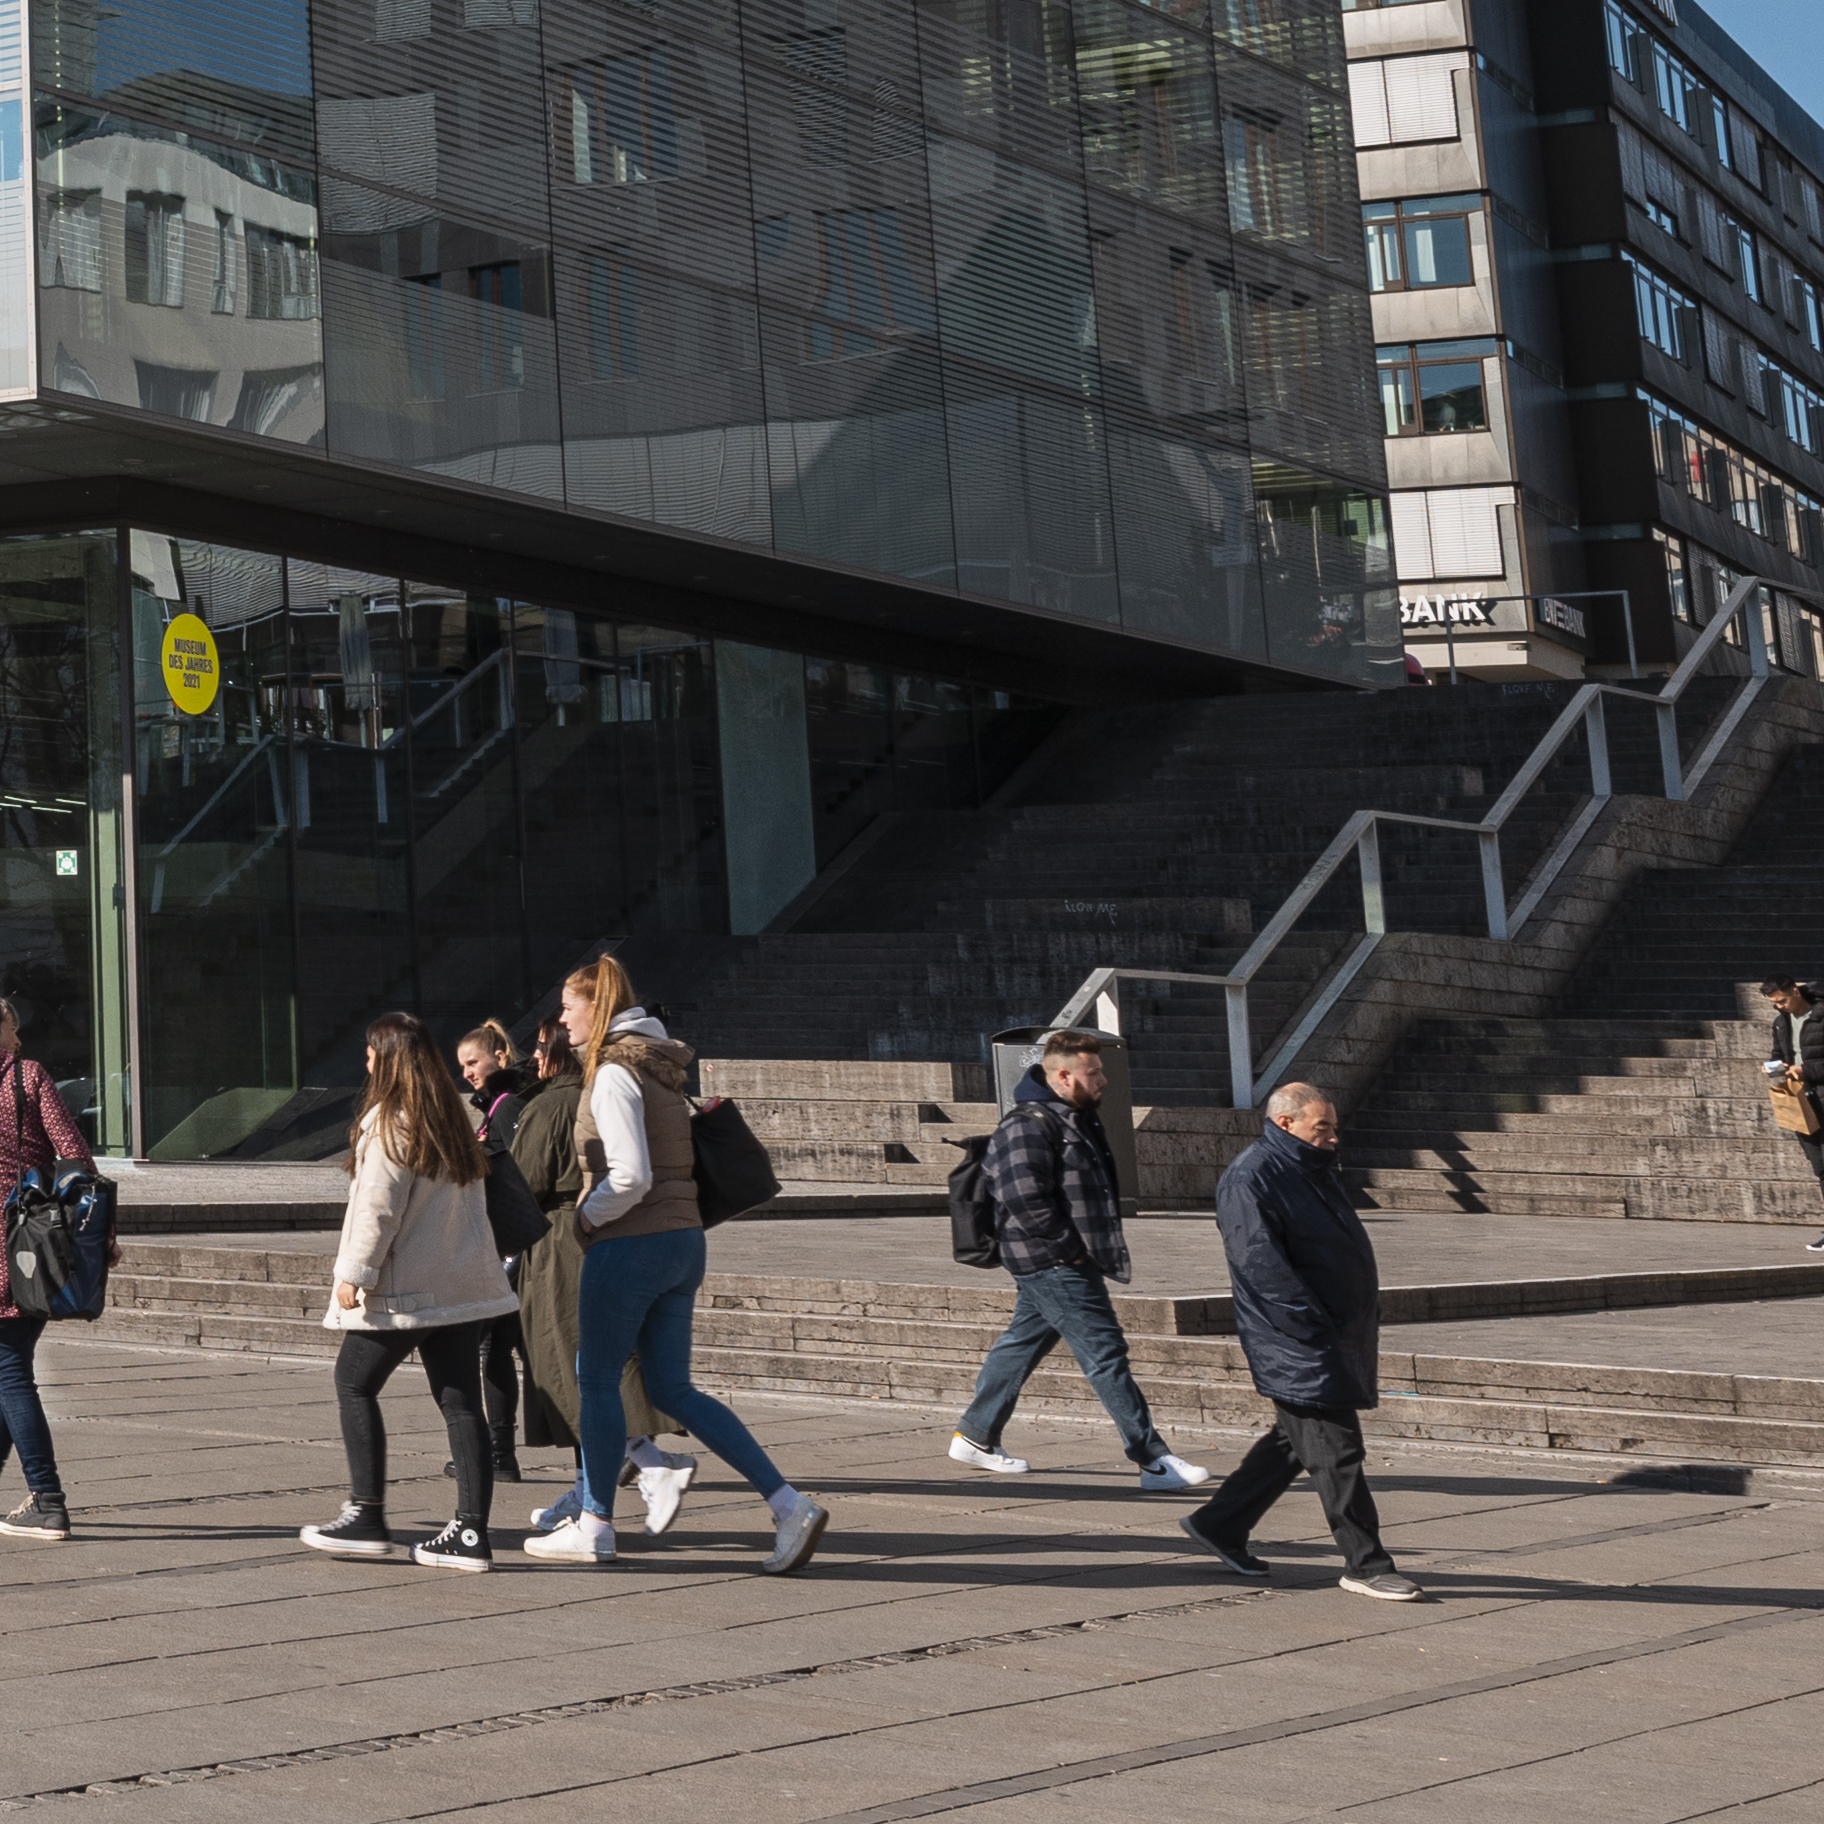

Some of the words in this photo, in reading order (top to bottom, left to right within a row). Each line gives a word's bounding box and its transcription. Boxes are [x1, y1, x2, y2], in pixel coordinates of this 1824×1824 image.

[174, 638, 207, 656] MUSEUM
[168, 654, 183, 670] DES
[185, 657, 213, 674] JAHRES
[183, 672, 200, 689] 2021
